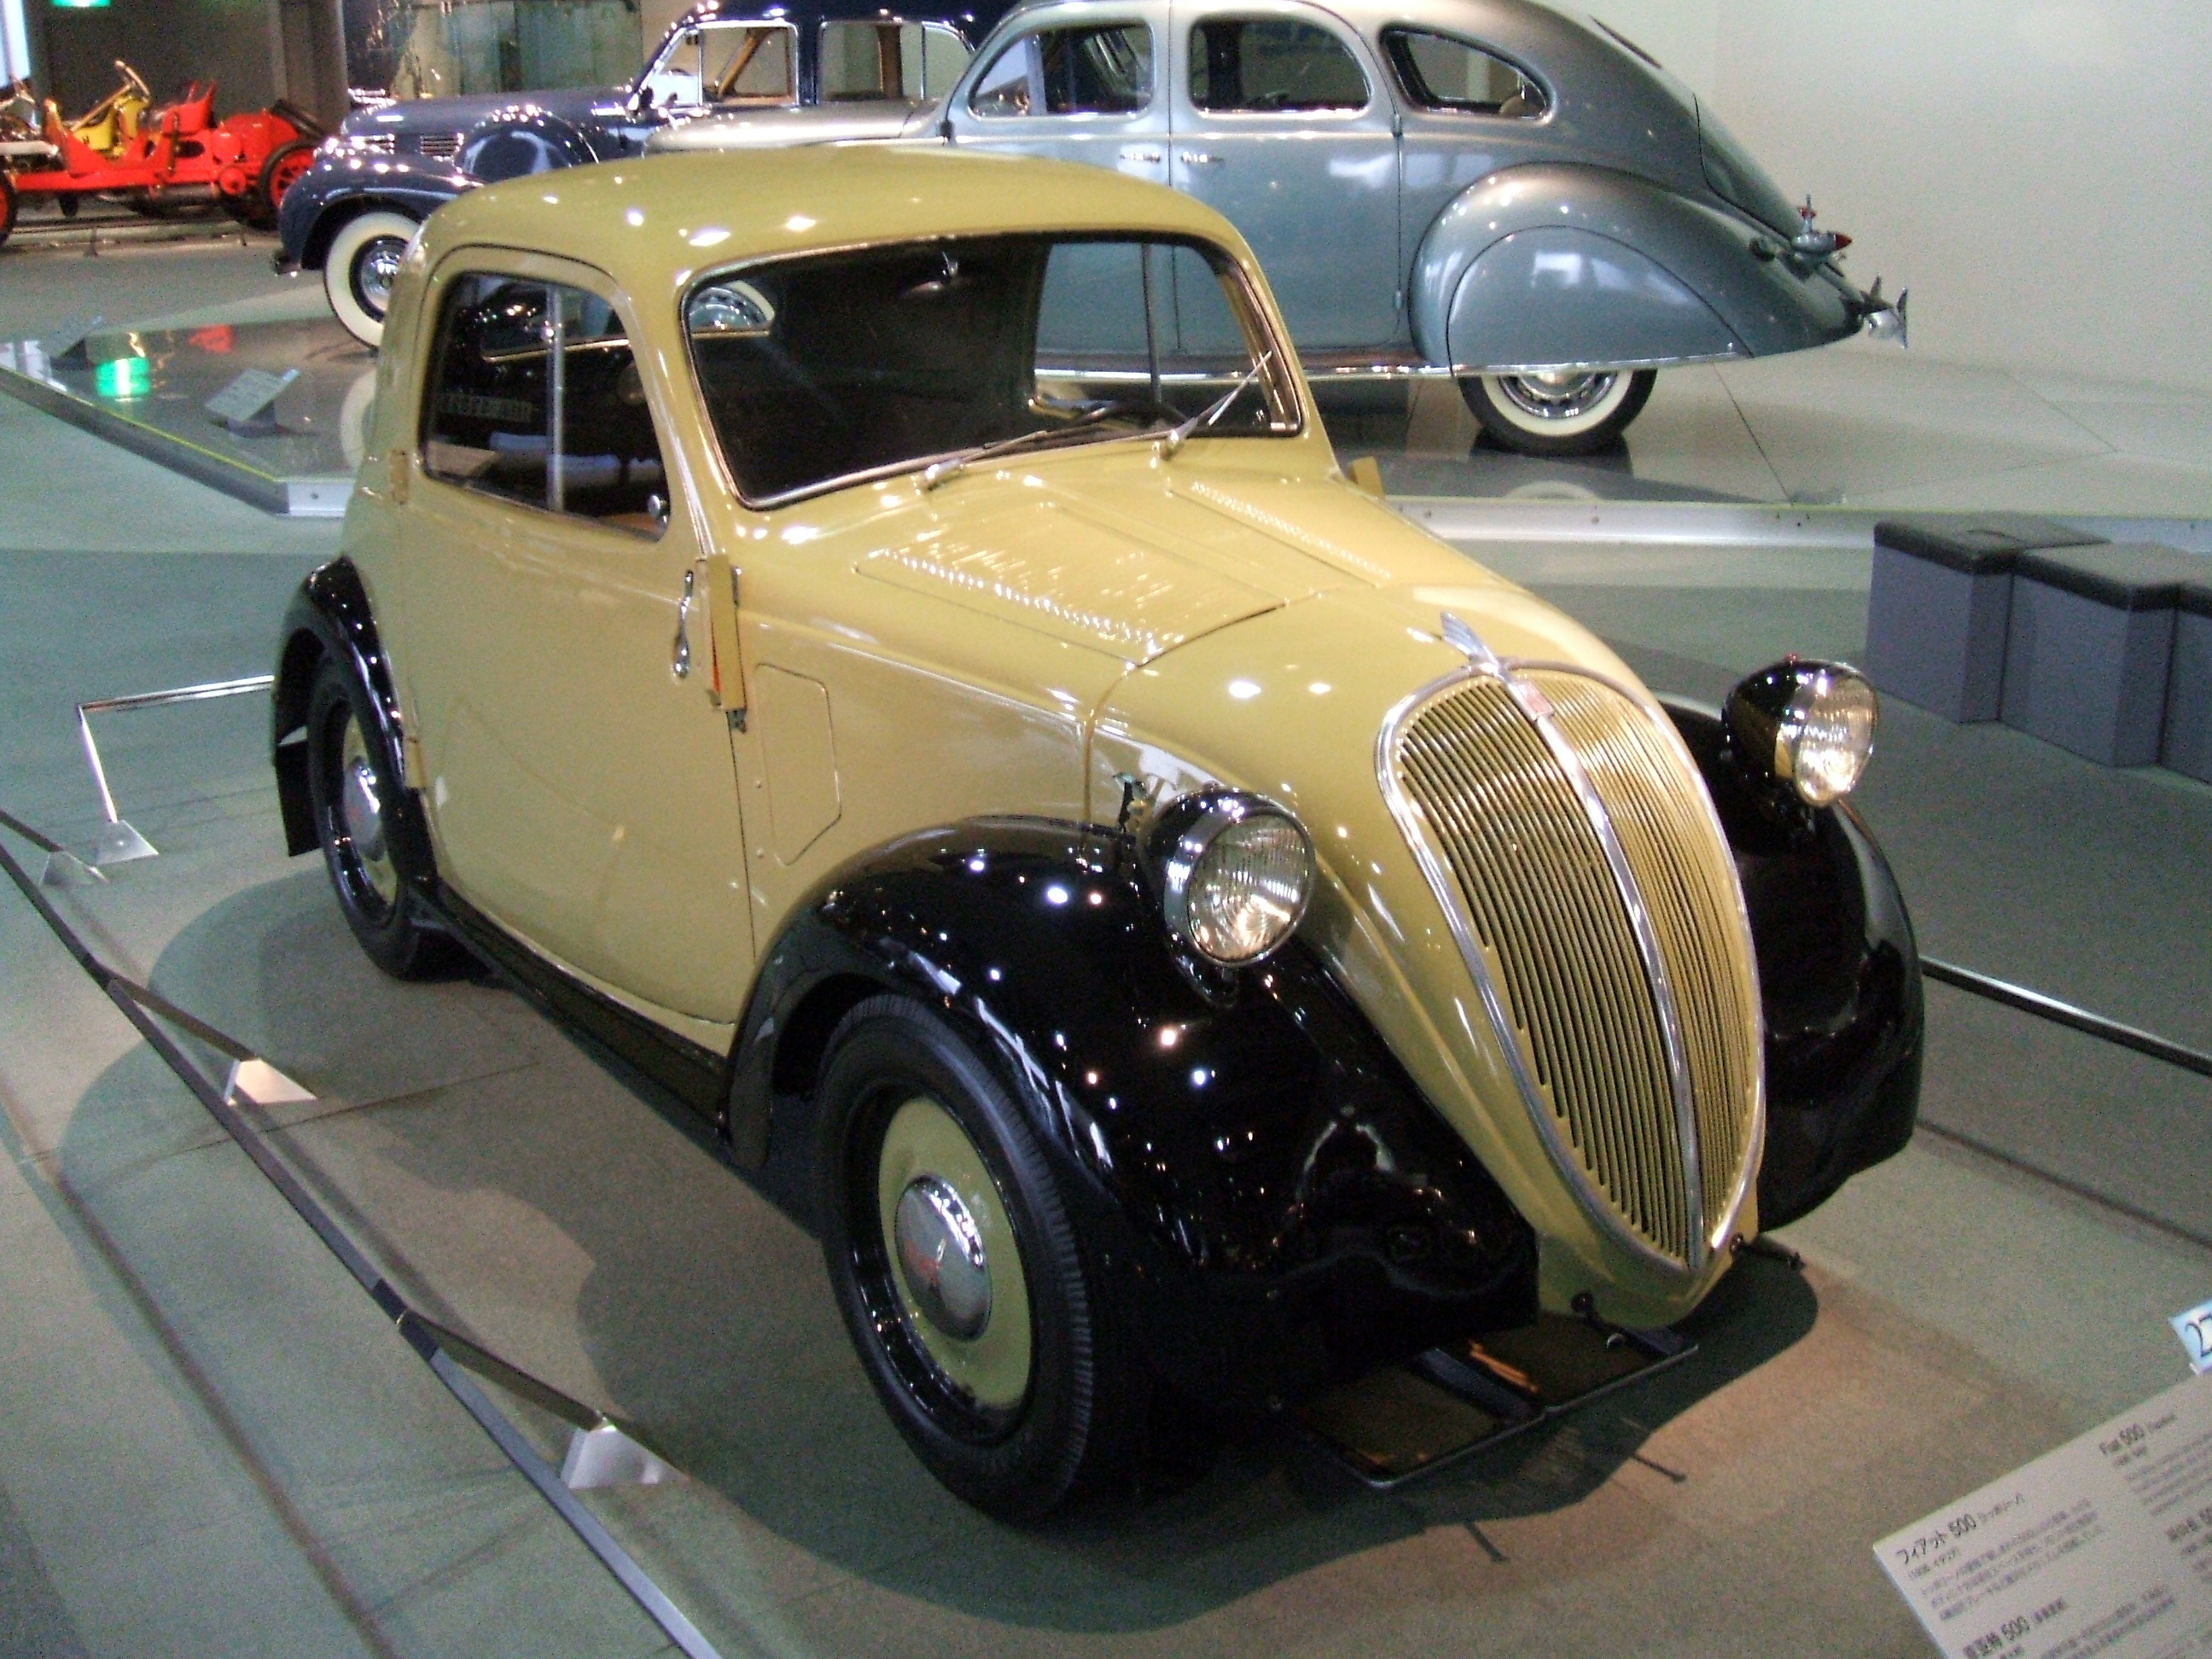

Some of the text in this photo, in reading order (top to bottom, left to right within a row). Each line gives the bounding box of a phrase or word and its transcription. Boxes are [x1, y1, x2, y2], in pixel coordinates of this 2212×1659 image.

[1895, 1528, 1948, 1565] フィアット
[1947, 1513, 1976, 1538] 500
